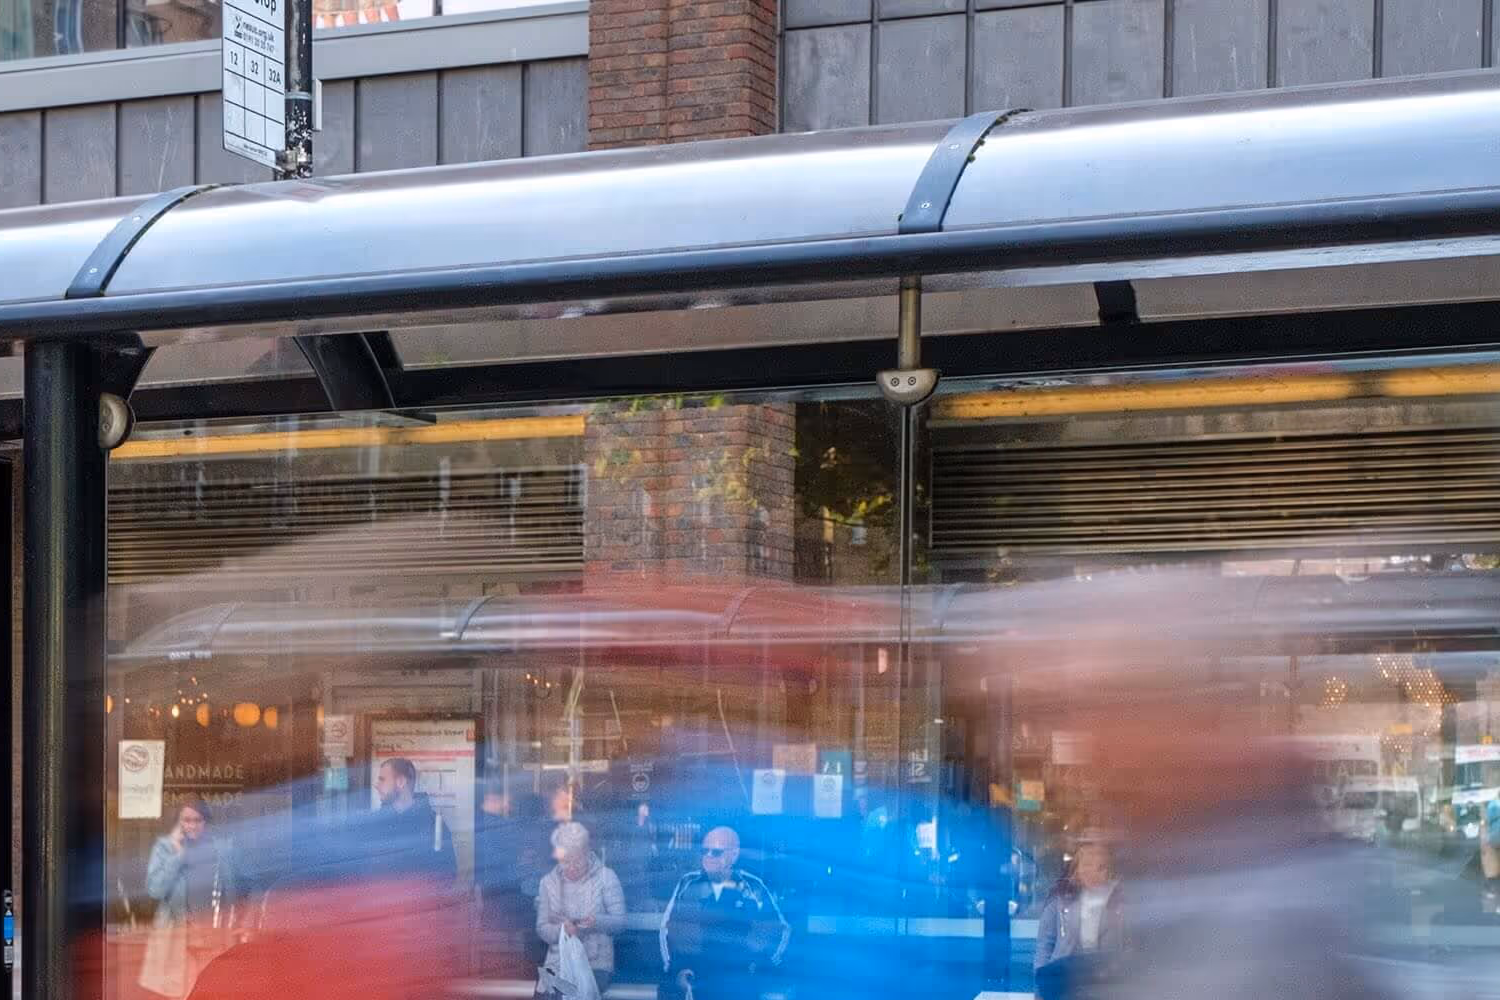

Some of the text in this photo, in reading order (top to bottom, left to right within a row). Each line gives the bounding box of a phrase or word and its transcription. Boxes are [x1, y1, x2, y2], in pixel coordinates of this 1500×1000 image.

[230, 51, 238, 66] 12
[251, 60, 259, 75] 32
[269, 68, 281, 85] 32A
[164, 764, 245, 780] ANDMADE
